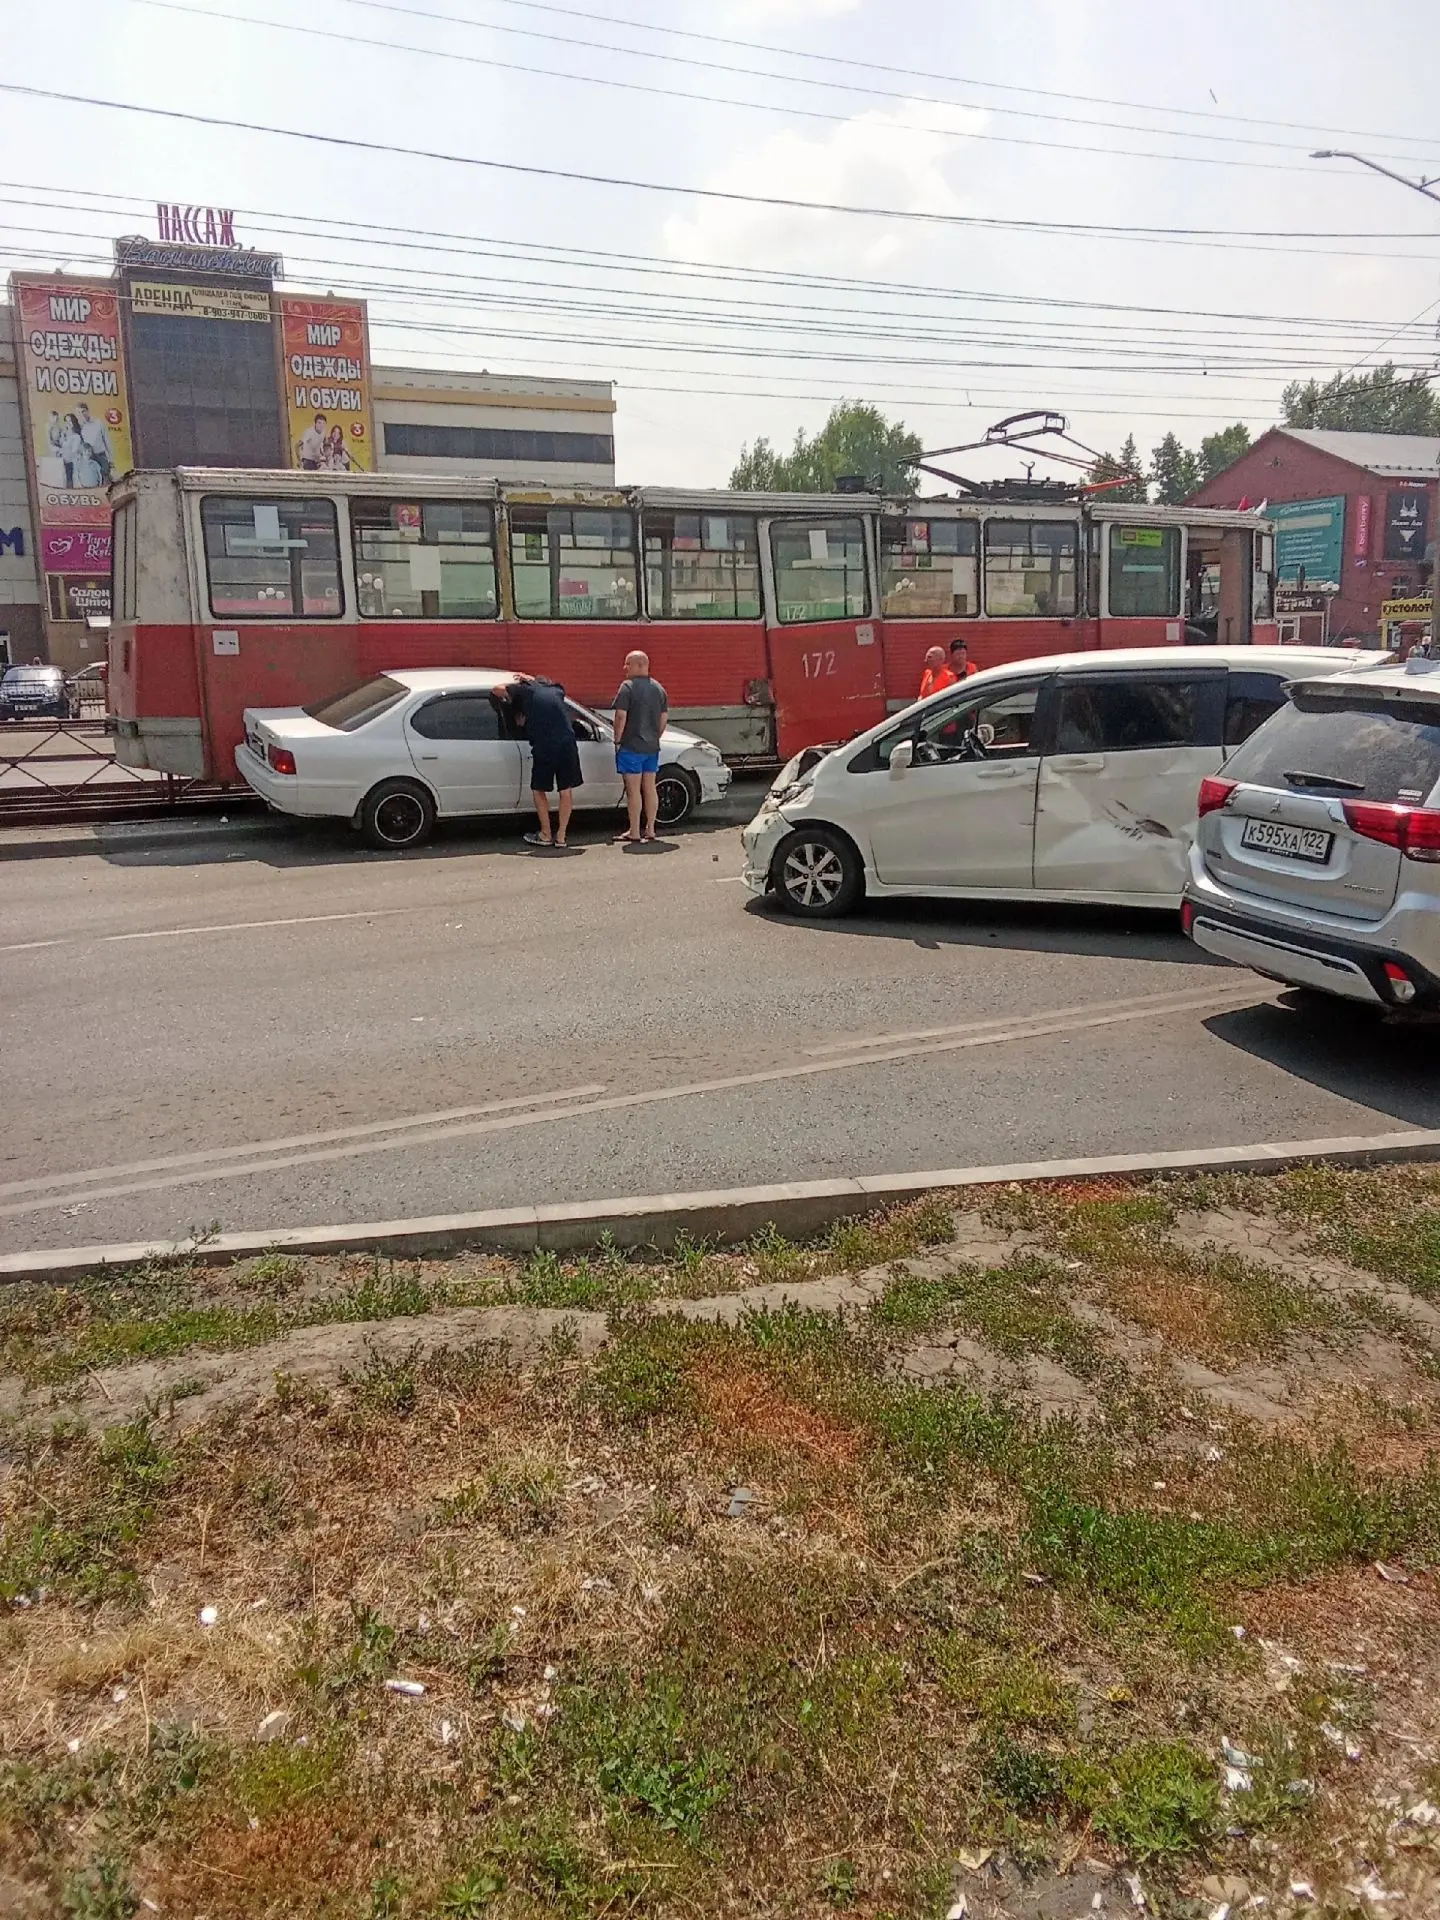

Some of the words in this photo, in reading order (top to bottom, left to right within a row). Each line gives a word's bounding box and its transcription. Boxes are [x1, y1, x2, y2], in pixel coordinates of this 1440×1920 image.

[156, 203, 236, 246] ПАССАЖ
[49, 295, 92, 323] МИР
[133, 287, 194, 311] АРЕНДА
[30, 329, 118, 364] ОДЕЖДЫ
[307, 323, 342, 347] МИР
[36, 366, 52, 392] И
[54, 367, 119, 396] ОБУВИ
[290, 354, 362, 383] ОДЕЖДЫ
[295, 386, 307, 408] И
[310, 387, 362, 411] ОБУВИ
[47, 494, 102, 506] ОБУВЬ
[69, 586, 110, 599] Салон
[801, 650, 837, 678] 172
[1247, 824, 1298, 850] К595ХА
[1303, 831, 1325, 850] 122
